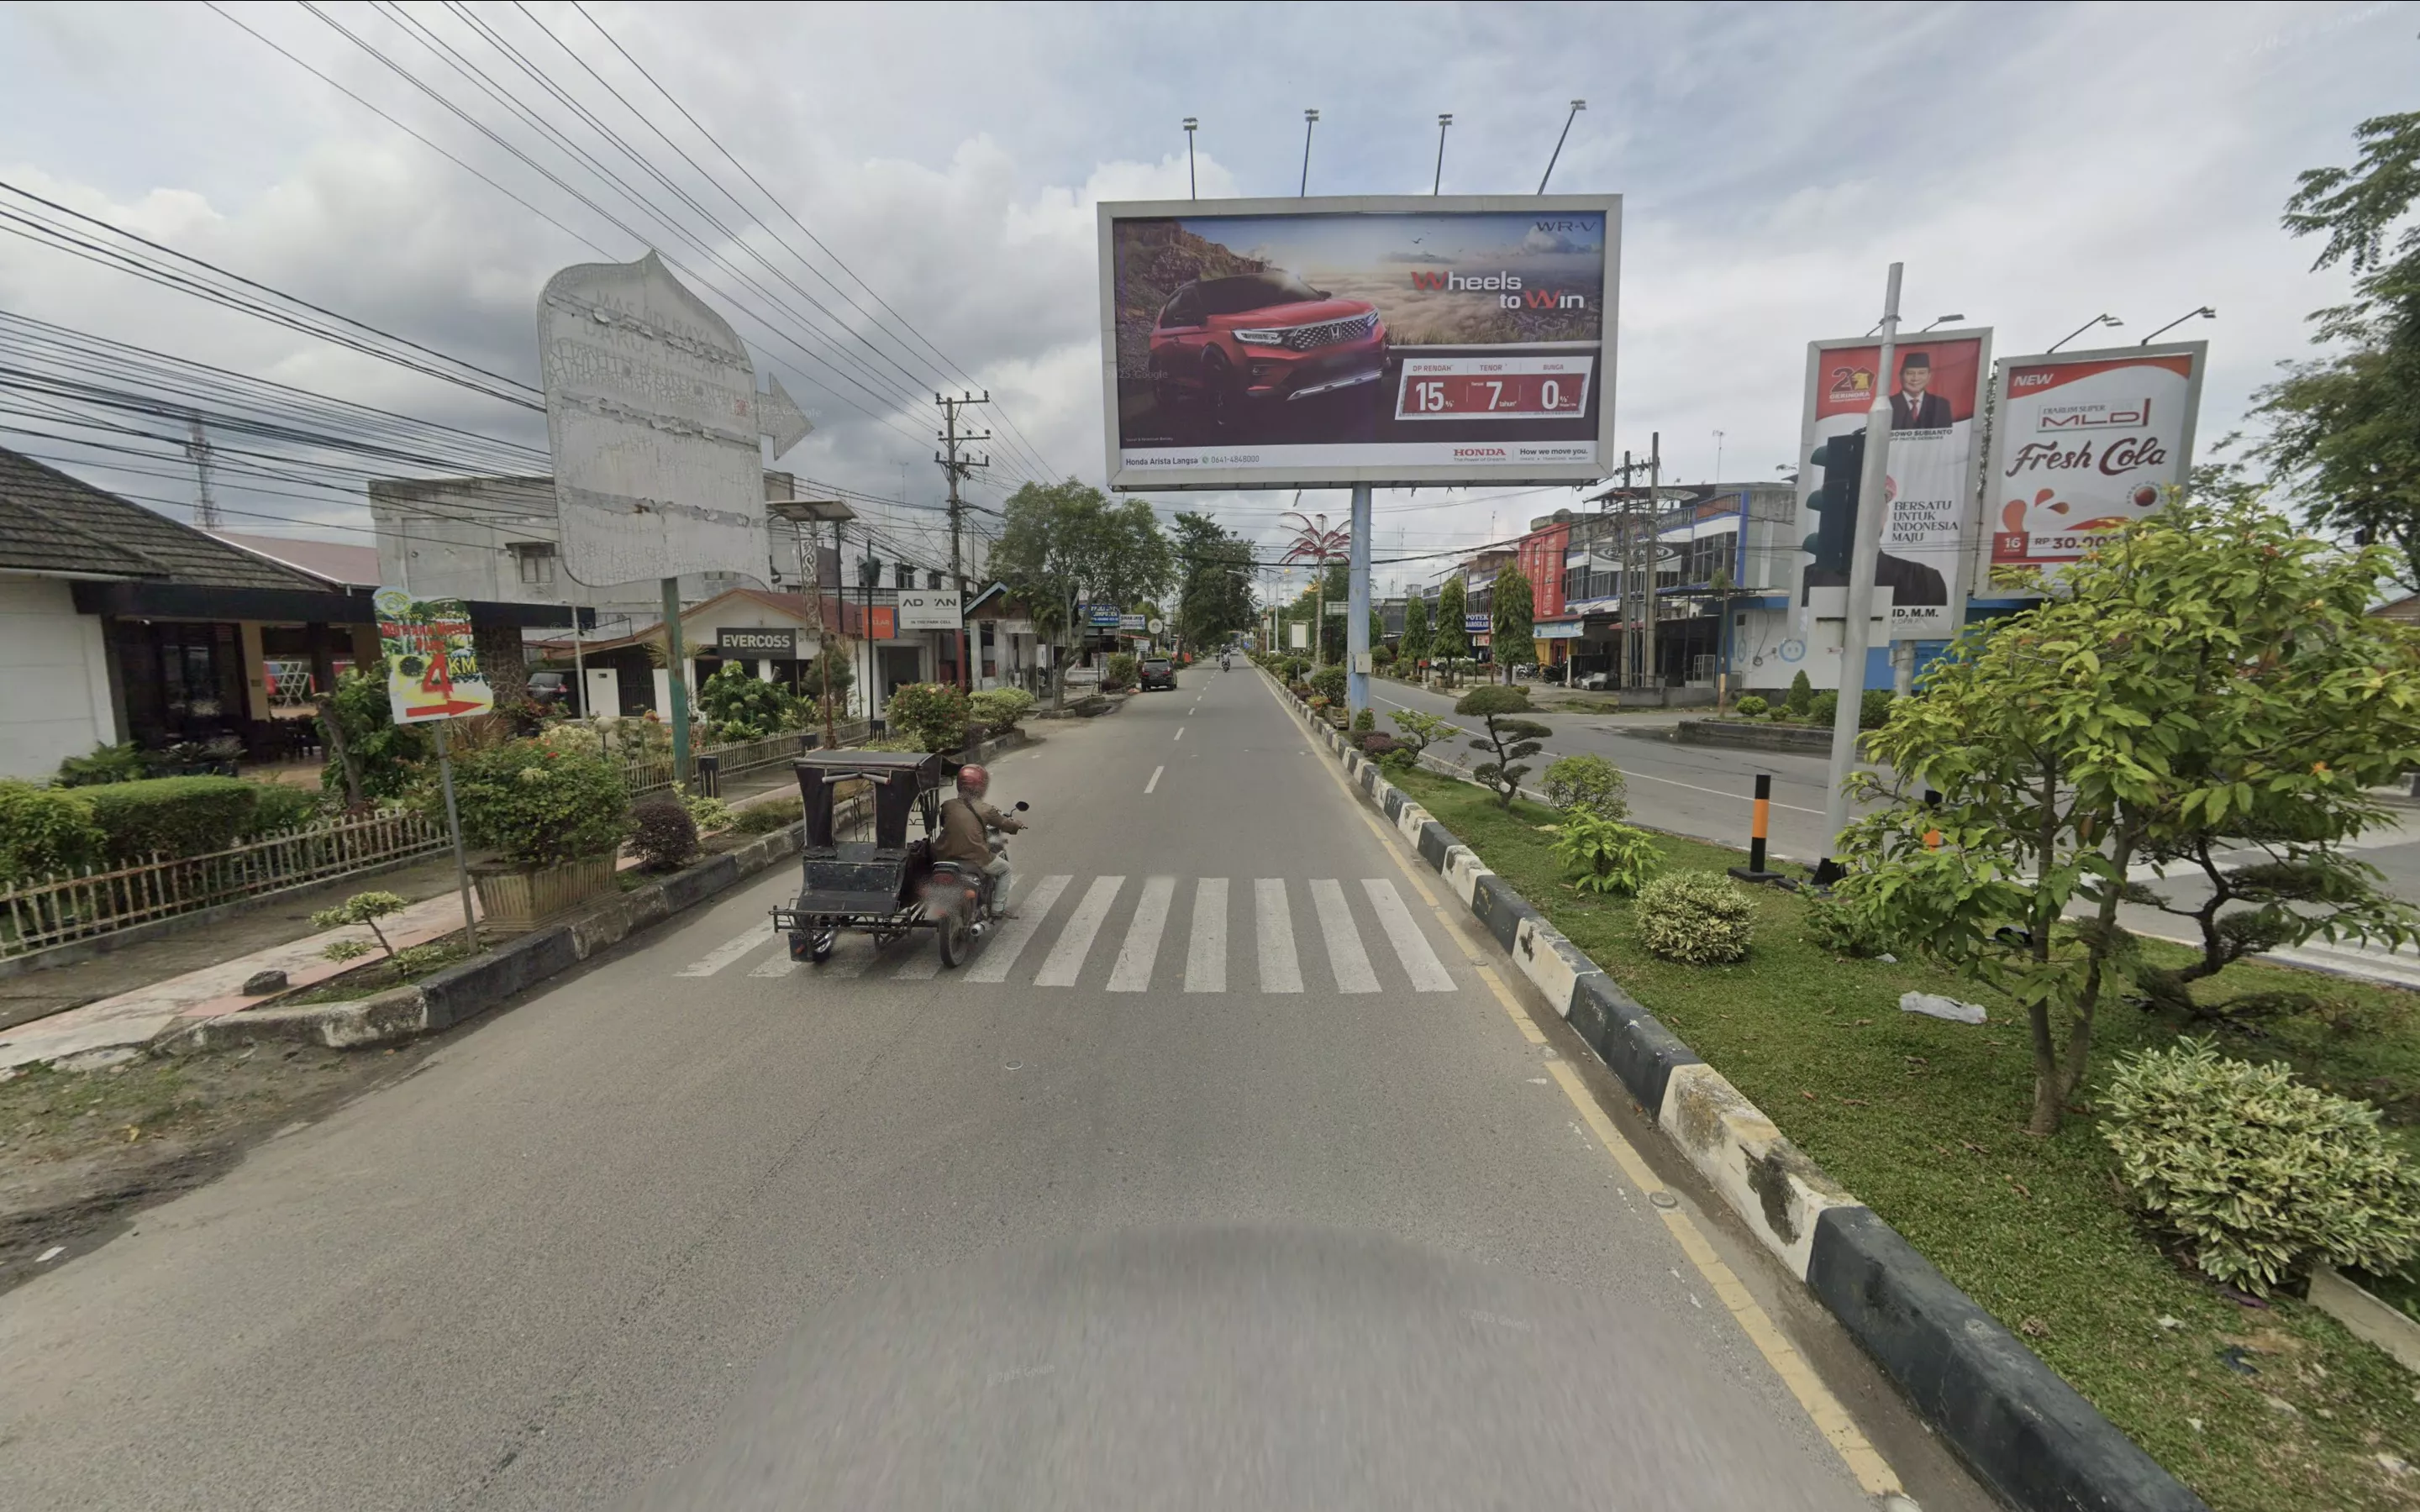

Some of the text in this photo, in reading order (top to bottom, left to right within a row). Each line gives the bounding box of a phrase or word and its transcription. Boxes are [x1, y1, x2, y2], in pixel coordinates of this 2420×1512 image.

[1535, 221, 1597, 232] WR-V
[1411, 270, 1522, 291] Wheels
[1499, 290, 1584, 309] to Win
[2013, 373, 2054, 386] NEW
[1486, 381, 1502, 410] 7
[2079, 404, 2106, 412] SUPER
[1453, 448, 1507, 456] HONDA
[1572, 448, 1588, 456] you.
[2005, 437, 2169, 477] Fresh Cola
[1150, 457, 1171, 465] Arista
[1173, 456, 1198, 466] Langsa
[1894, 500, 1952, 511] BERSATU
[1893, 512, 1936, 521] UNTUK
[1892, 521, 1958, 531] INDONESIA
[1891, 532, 1924, 543] MAJU
[2004, 537, 2022, 549] 16
[902, 598, 957, 606] ADAN
[722, 634, 791, 648] EVERCOSS
[421, 653, 476, 699] 4 KM
